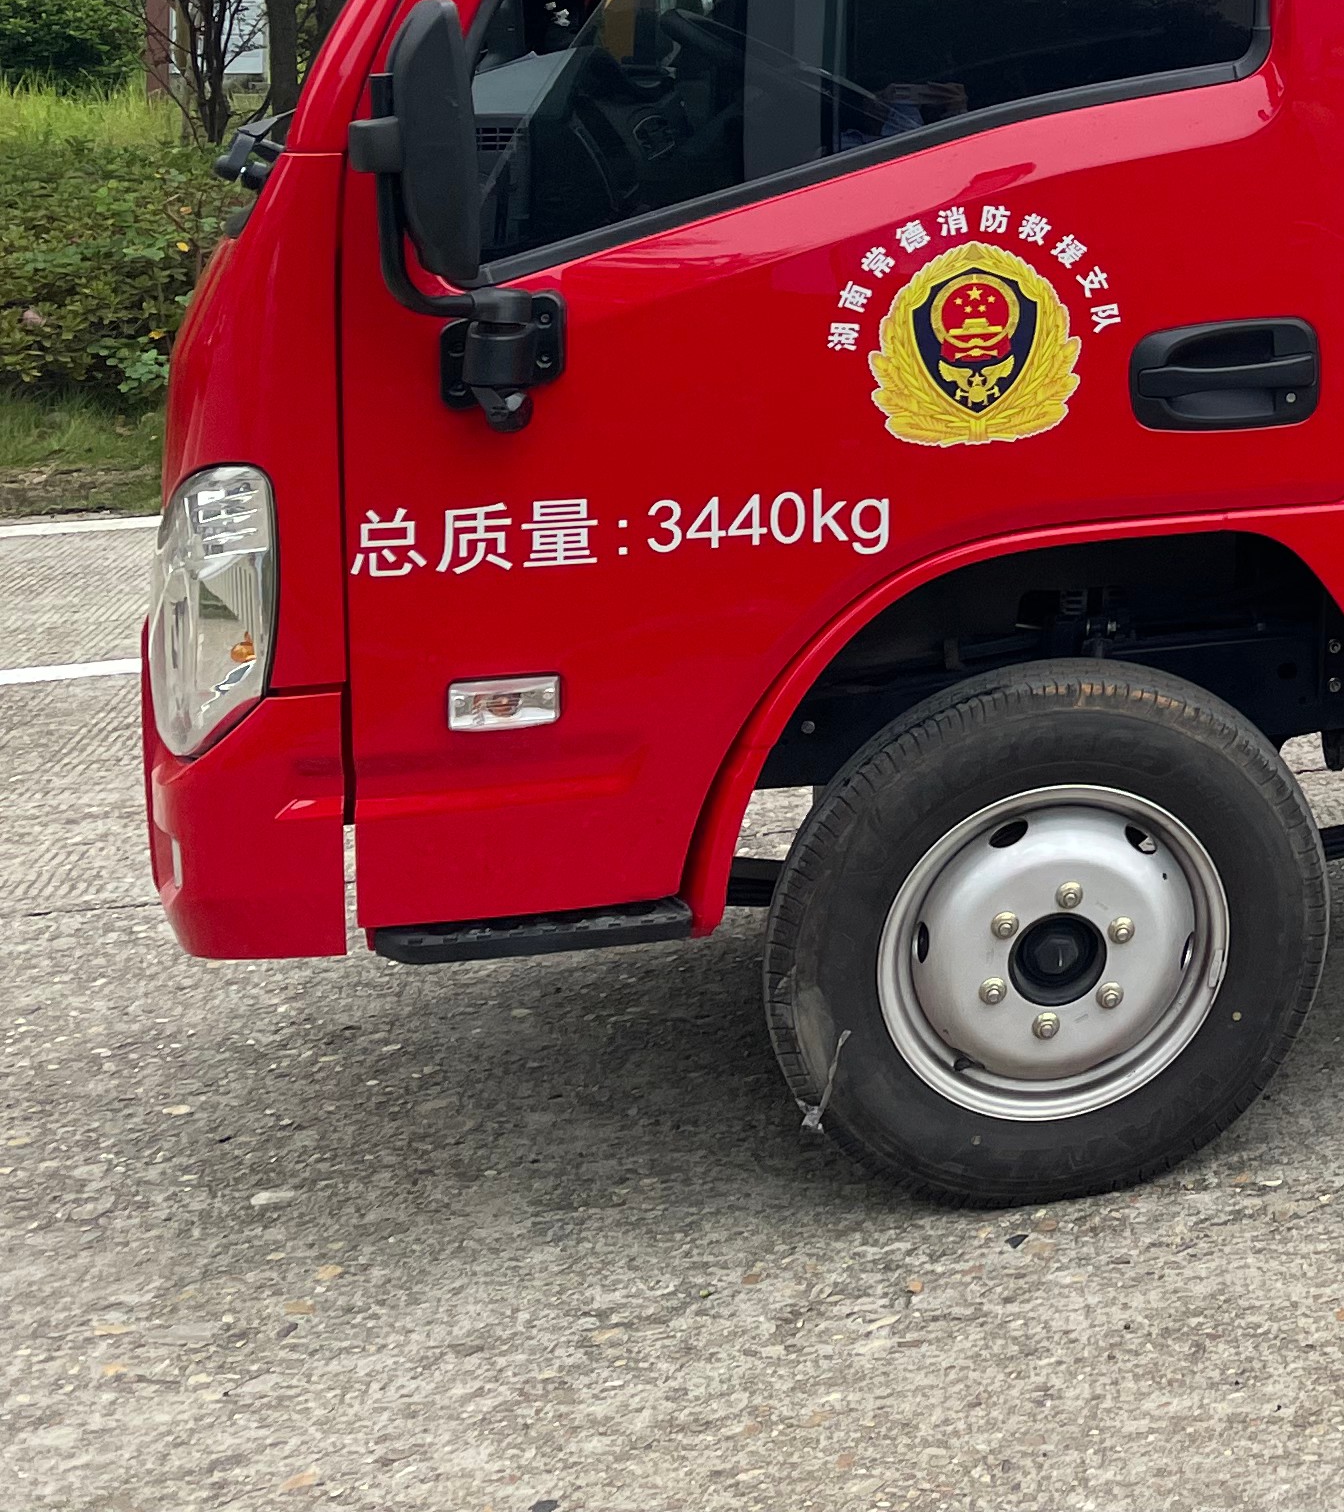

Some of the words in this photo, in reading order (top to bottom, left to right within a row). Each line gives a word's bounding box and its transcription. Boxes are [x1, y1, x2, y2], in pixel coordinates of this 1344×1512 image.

[827, 205, 1121, 352] 湖南常德消防救援支队
